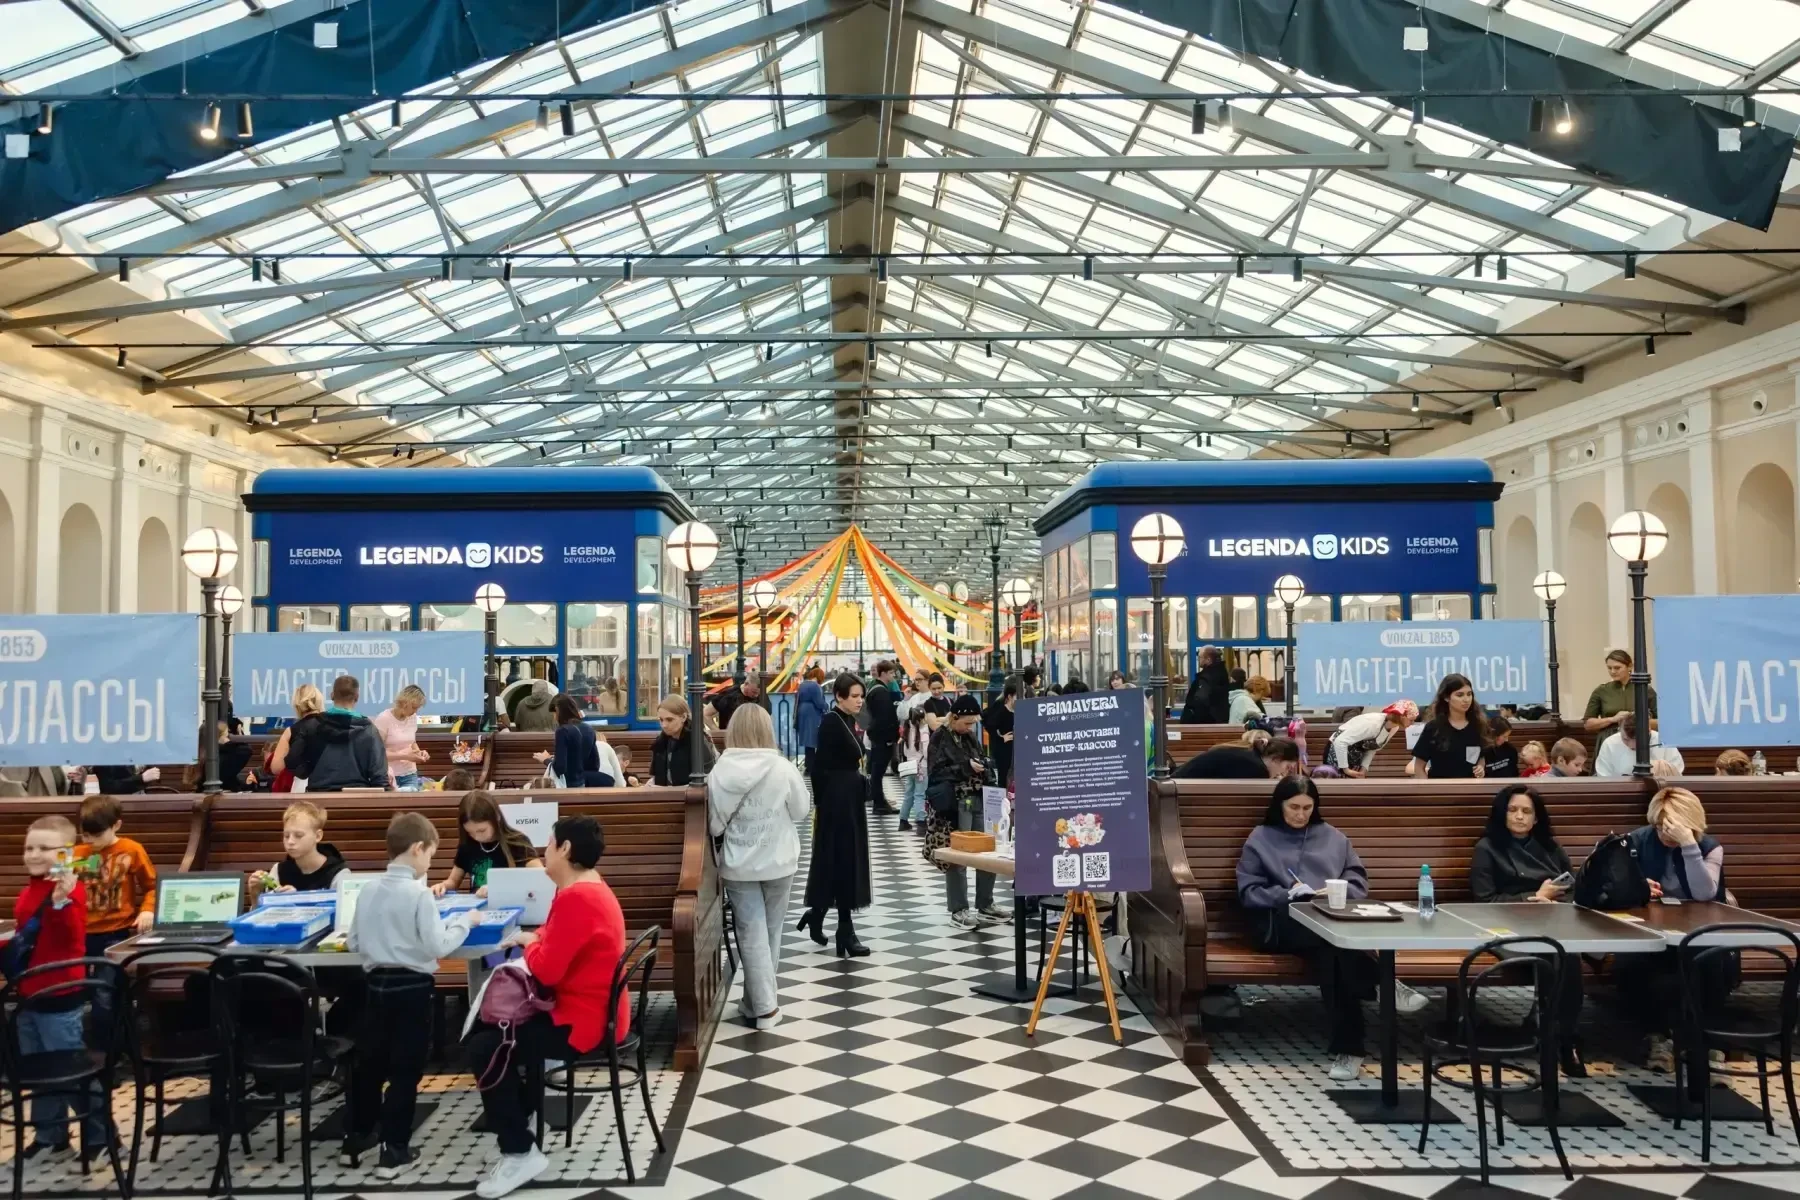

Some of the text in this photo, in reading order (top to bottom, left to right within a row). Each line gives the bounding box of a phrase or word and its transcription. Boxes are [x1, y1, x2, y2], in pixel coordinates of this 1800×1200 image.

[1209, 538, 1311, 557] LEGENDA
[1341, 536, 1390, 555] KIDS
[1407, 537, 1459, 547] LEGENDA
[290, 548, 342, 557] LEGENDA
[360, 545, 544, 565] LEGENDA KIDS
[563, 546, 616, 556] LEGENDA
[1387, 631, 1455, 645] VOKZAL 1853
[325, 642, 393, 656] VOKZAL 1853
[1037, 696, 1119, 716] PRIMAVERA
[1070, 711, 1110, 721] EXPRESSION
